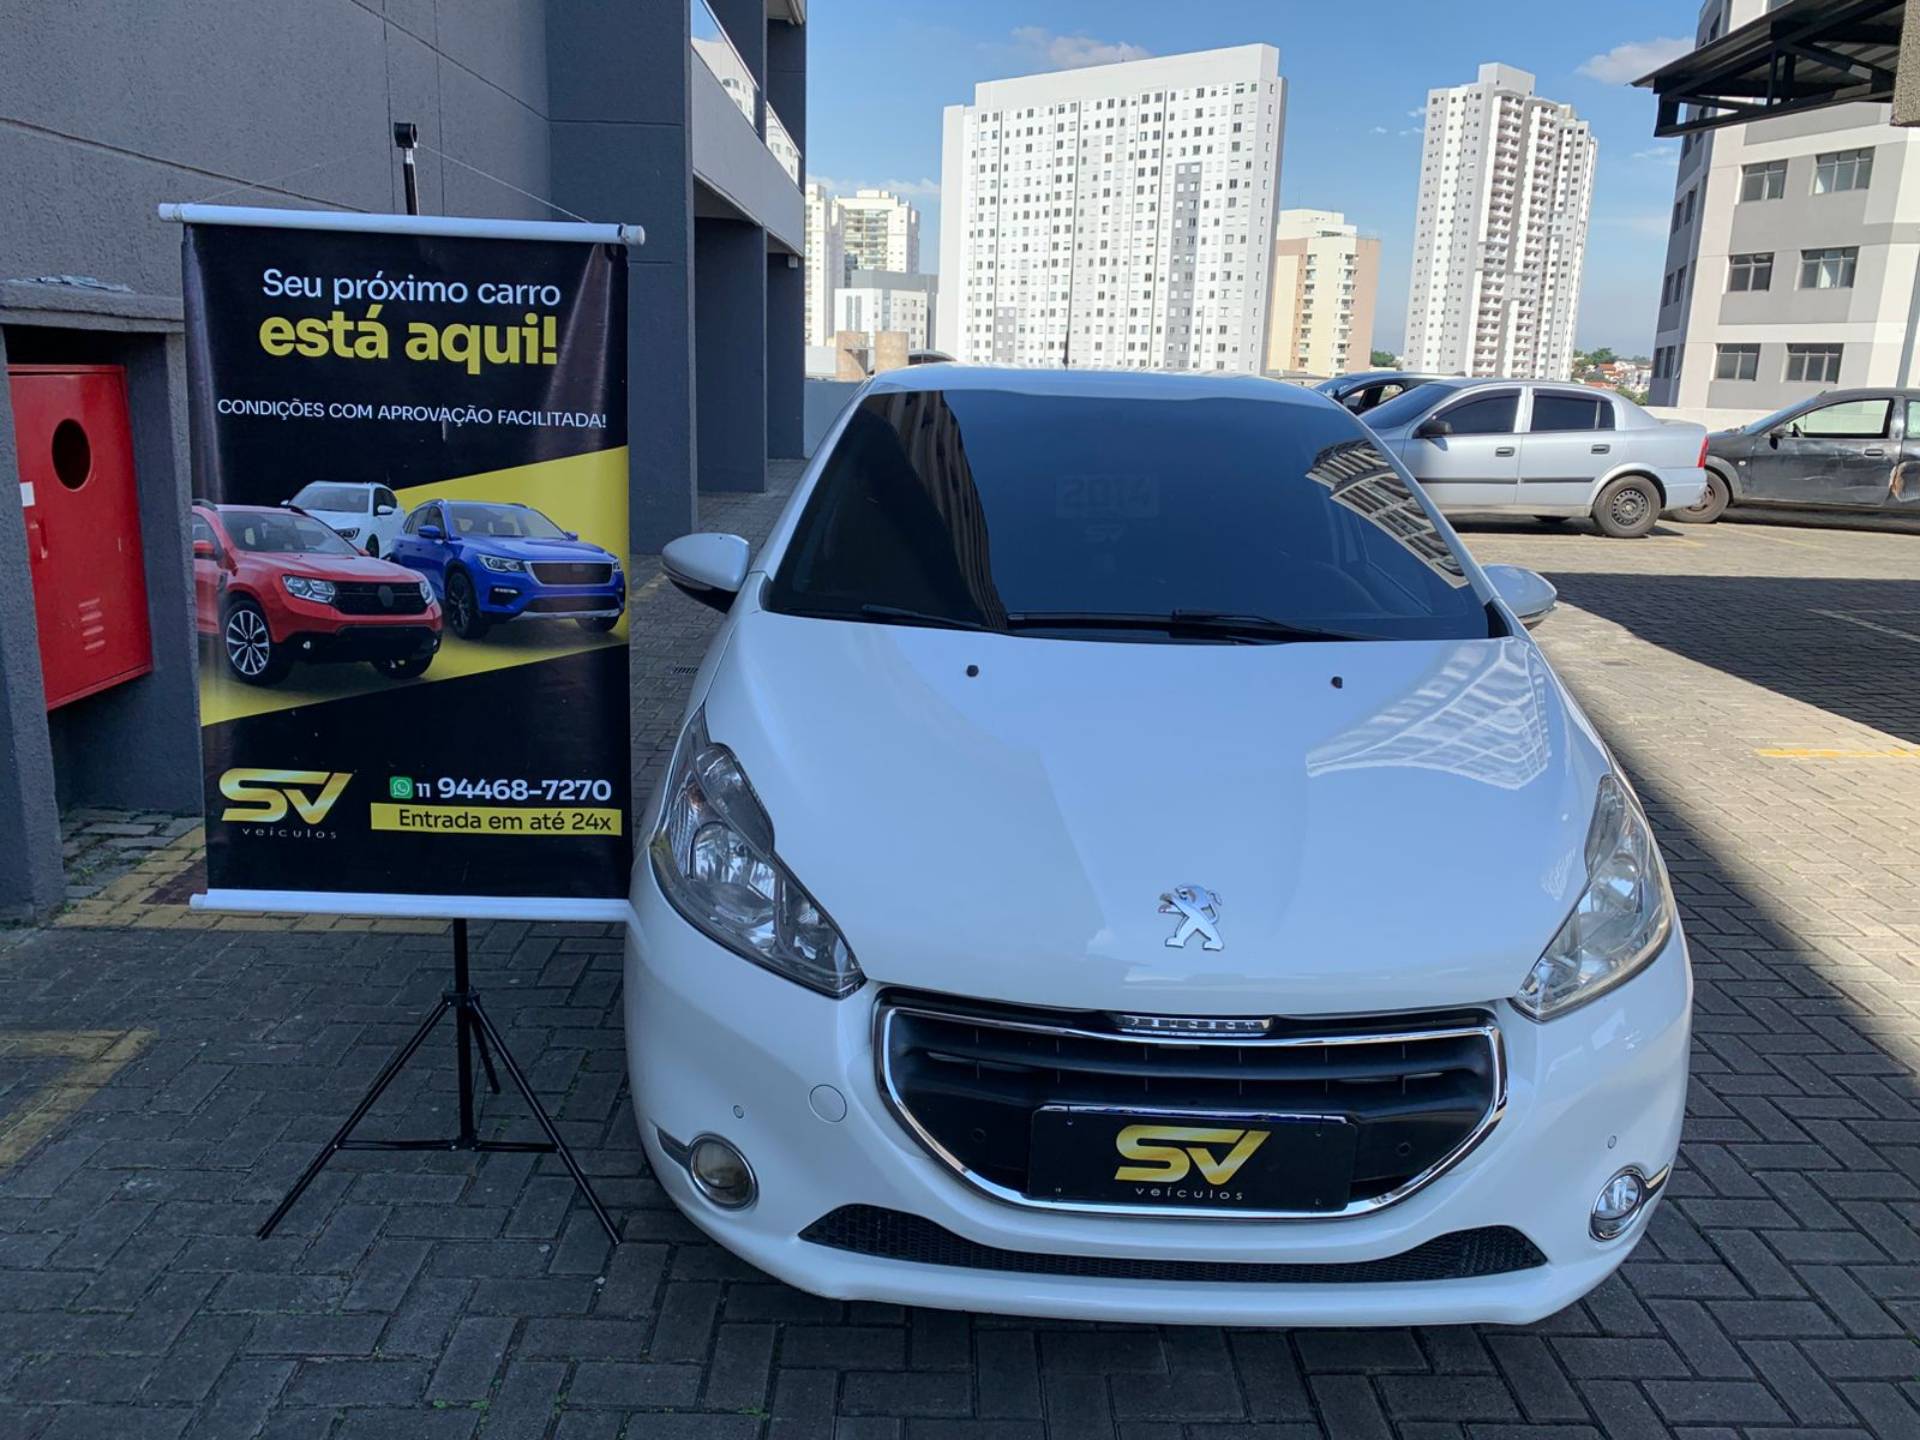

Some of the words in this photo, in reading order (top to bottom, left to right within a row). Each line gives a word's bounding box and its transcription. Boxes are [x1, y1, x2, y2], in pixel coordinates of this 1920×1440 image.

[263, 268, 322, 298] Seu
[333, 270, 469, 305] próximo
[477, 281, 561, 306] carro
[259, 304, 389, 360] está
[405, 313, 558, 376] aqui!
[217, 399, 325, 421] CONDIÇÕES
[328, 404, 373, 420] COM
[378, 405, 493, 429] APROVAÇÃO
[497, 412, 607, 429] FACILITADA!
[219, 768, 353, 824] SV
[416, 783, 431, 797] 11
[438, 777, 612, 801] 94468-7270
[399, 809, 482, 829] Entrada
[488, 814, 524, 831] em
[529, 812, 566, 831] até
[571, 814, 612, 831] 24x
[1114, 1125, 1271, 1185] SV
[1135, 1186, 1243, 1201] veículos
